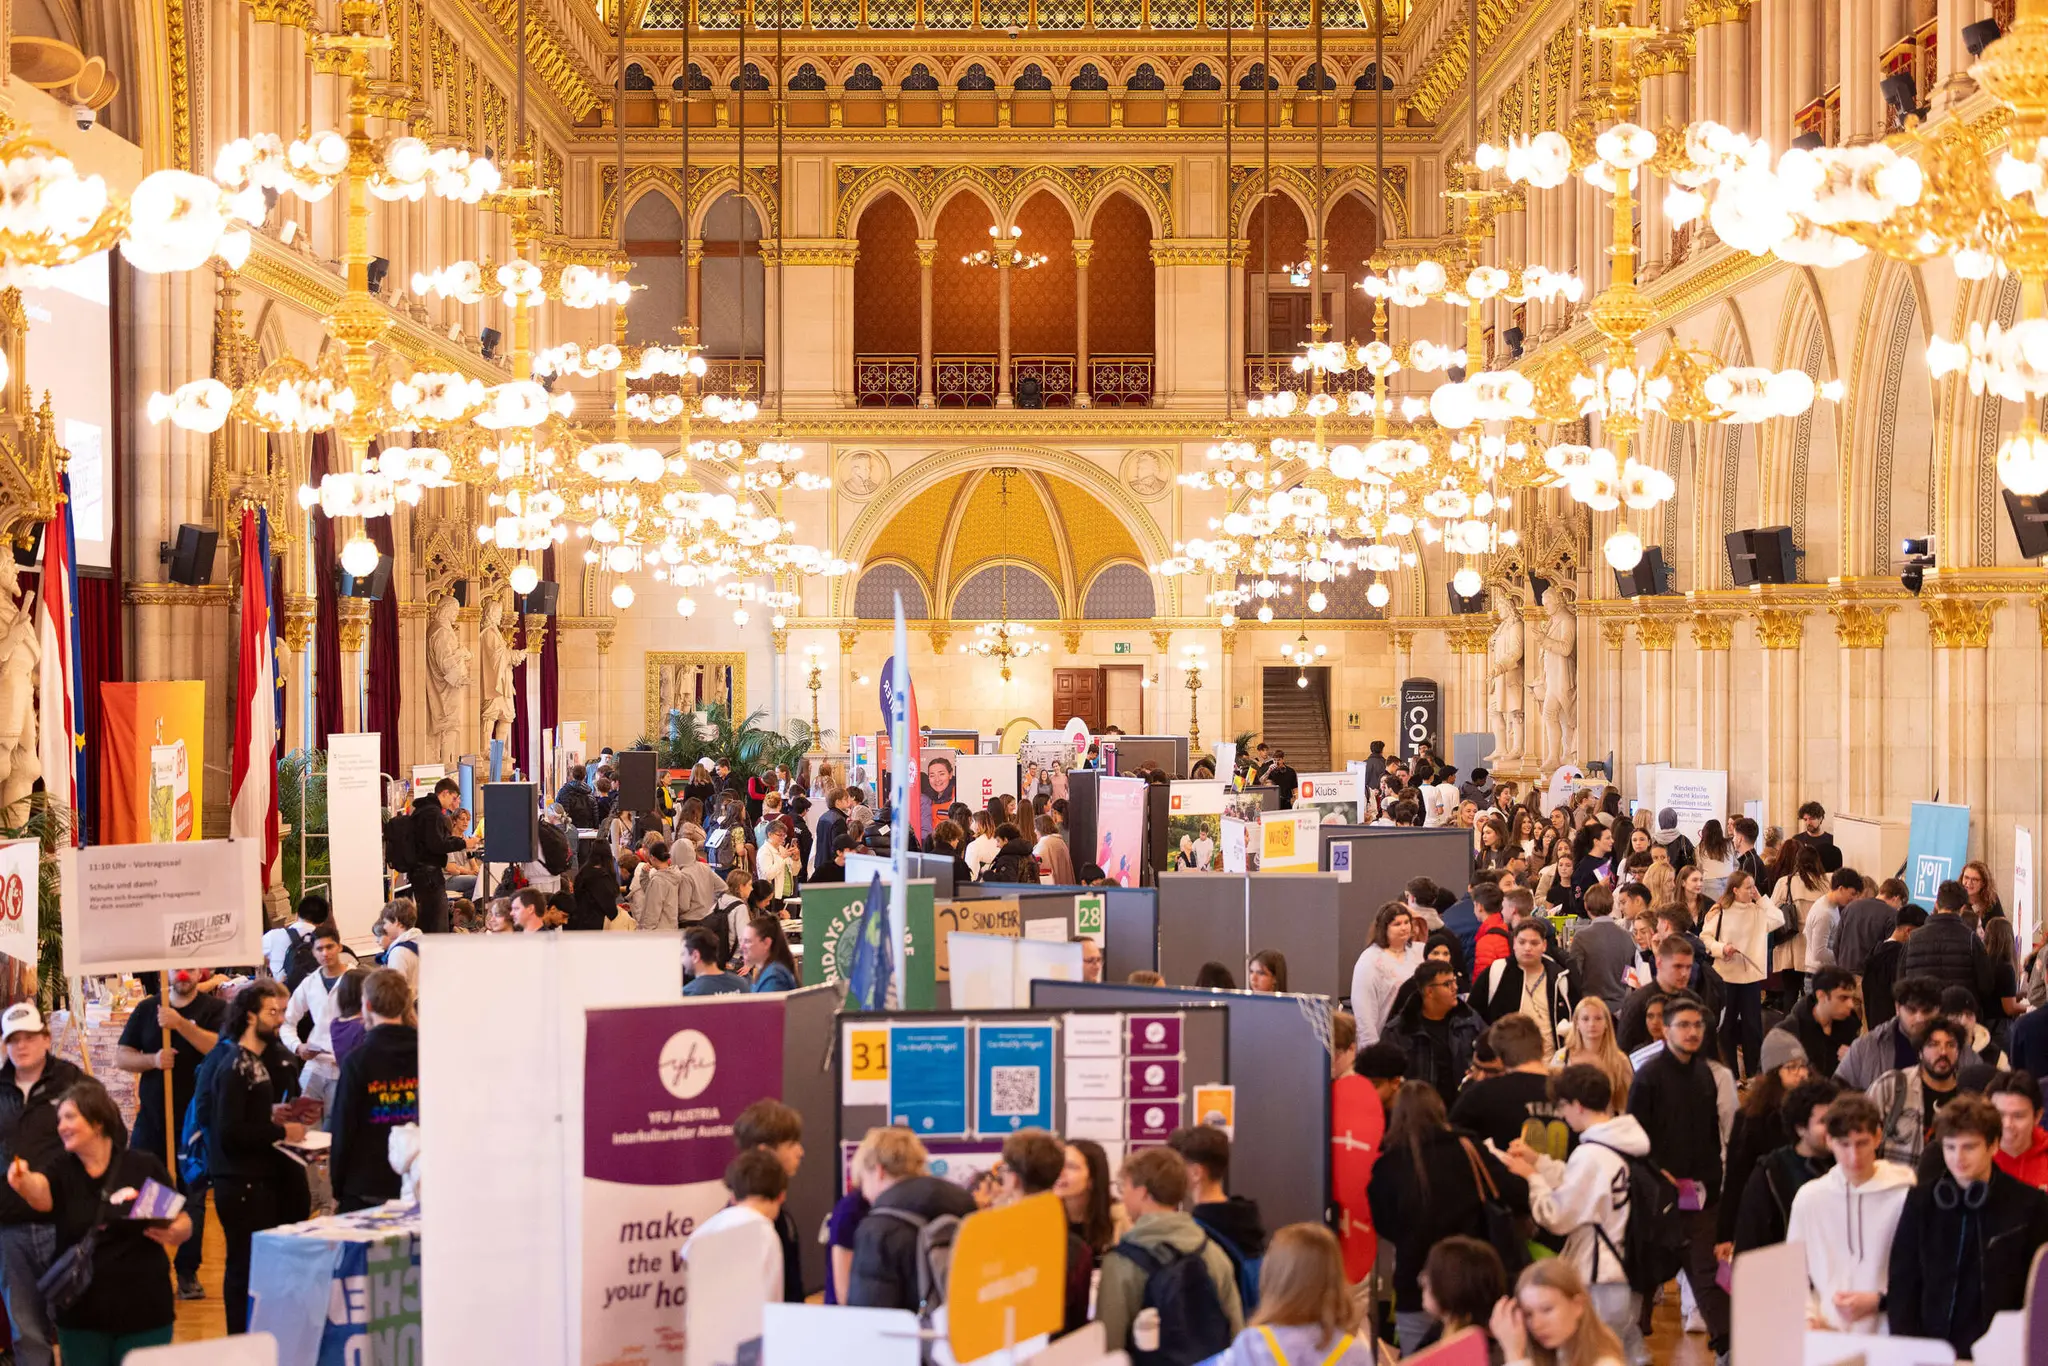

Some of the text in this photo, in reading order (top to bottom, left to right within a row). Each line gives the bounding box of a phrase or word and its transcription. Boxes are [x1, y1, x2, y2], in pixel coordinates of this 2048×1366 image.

[1408, 706, 1428, 767] COF
[982, 778, 993, 809] ITER
[1314, 786, 1338, 796] Klubs
[1673, 785, 1708, 793] Kinderhilfe
[1667, 799, 1697, 807] Patienten
[88, 862, 110, 872] 11:10
[111, 861, 127, 870] Uhr
[133, 859, 182, 870] Vortragssaal
[1334, 850, 1349, 866] 25
[89, 880, 158, 891] Schule und dann?
[89, 895, 113, 903] Warum
[162, 890, 201, 900] Engagement
[842, 900, 865, 922] FO
[972, 911, 995, 930] SIND
[995, 909, 1021, 929] MEHR
[1079, 907, 1100, 928] 28
[172, 913, 232, 934] FREIWILLIGEN
[170, 929, 205, 948] MESSE
[853, 1043, 888, 1071] 31
[648, 1106, 721, 1124] YFU AUSTRIA
[612, 1125, 735, 1146] Interkultureller Austau
[620, 1210, 695, 1243] make
[627, 1252, 662, 1275] the
[603, 1280, 687, 1309] your ho
